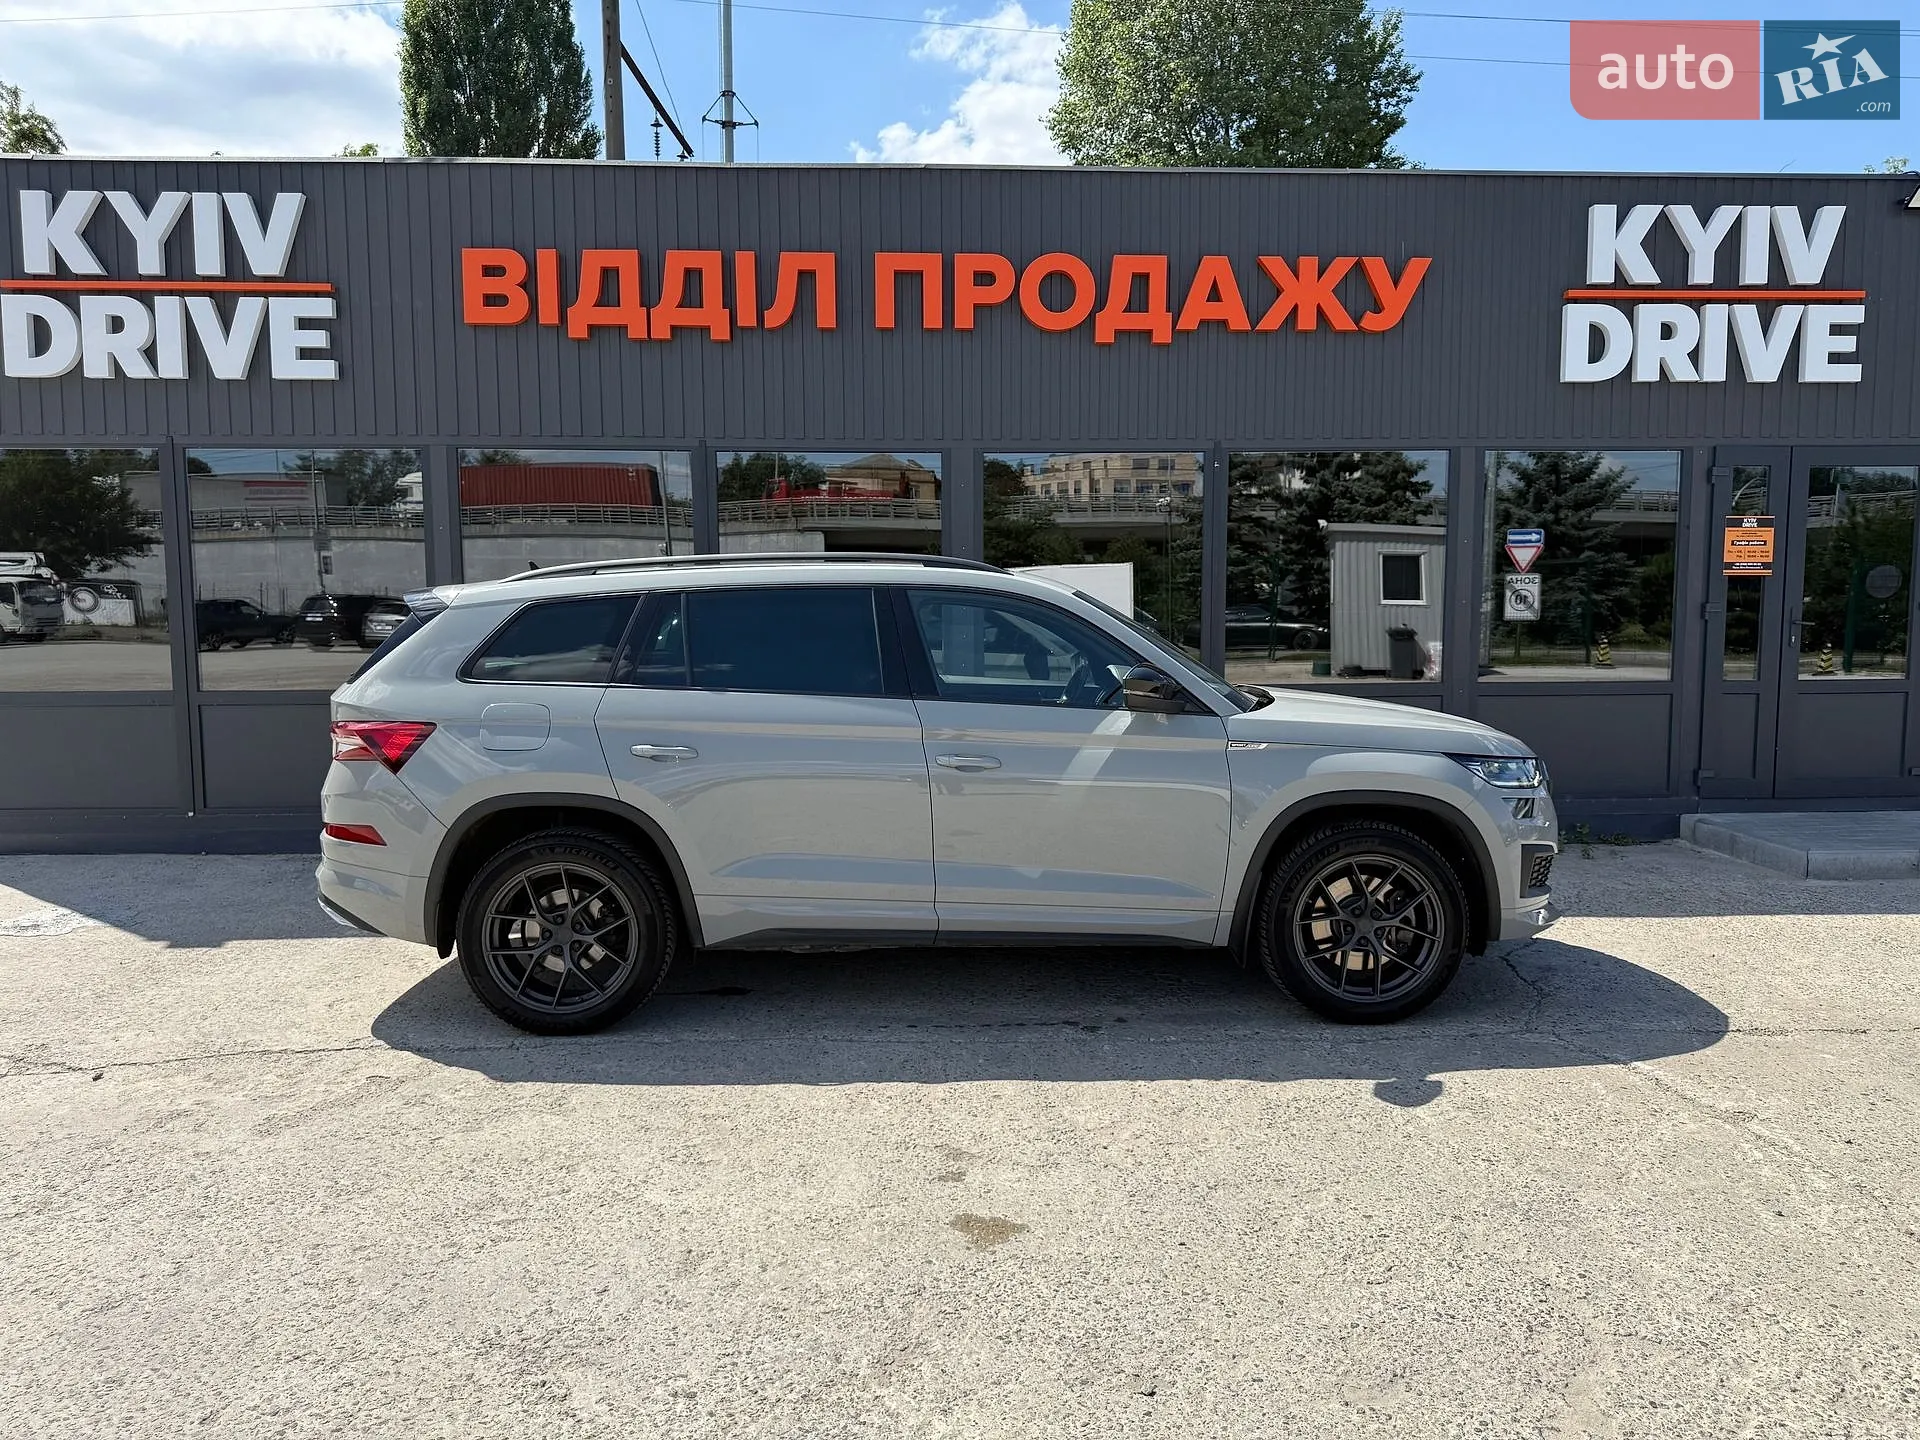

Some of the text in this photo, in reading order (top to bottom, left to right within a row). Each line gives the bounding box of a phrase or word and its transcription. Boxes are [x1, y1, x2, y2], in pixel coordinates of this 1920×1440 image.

[19, 189, 307, 277] KYIV
[1586, 204, 1847, 285] KYIV
[0, 294, 340, 380] DRIVE
[461, 247, 1433, 344] ВІДДІЛ ПРОДАЖУ
[1560, 303, 1866, 383] DRIVE
